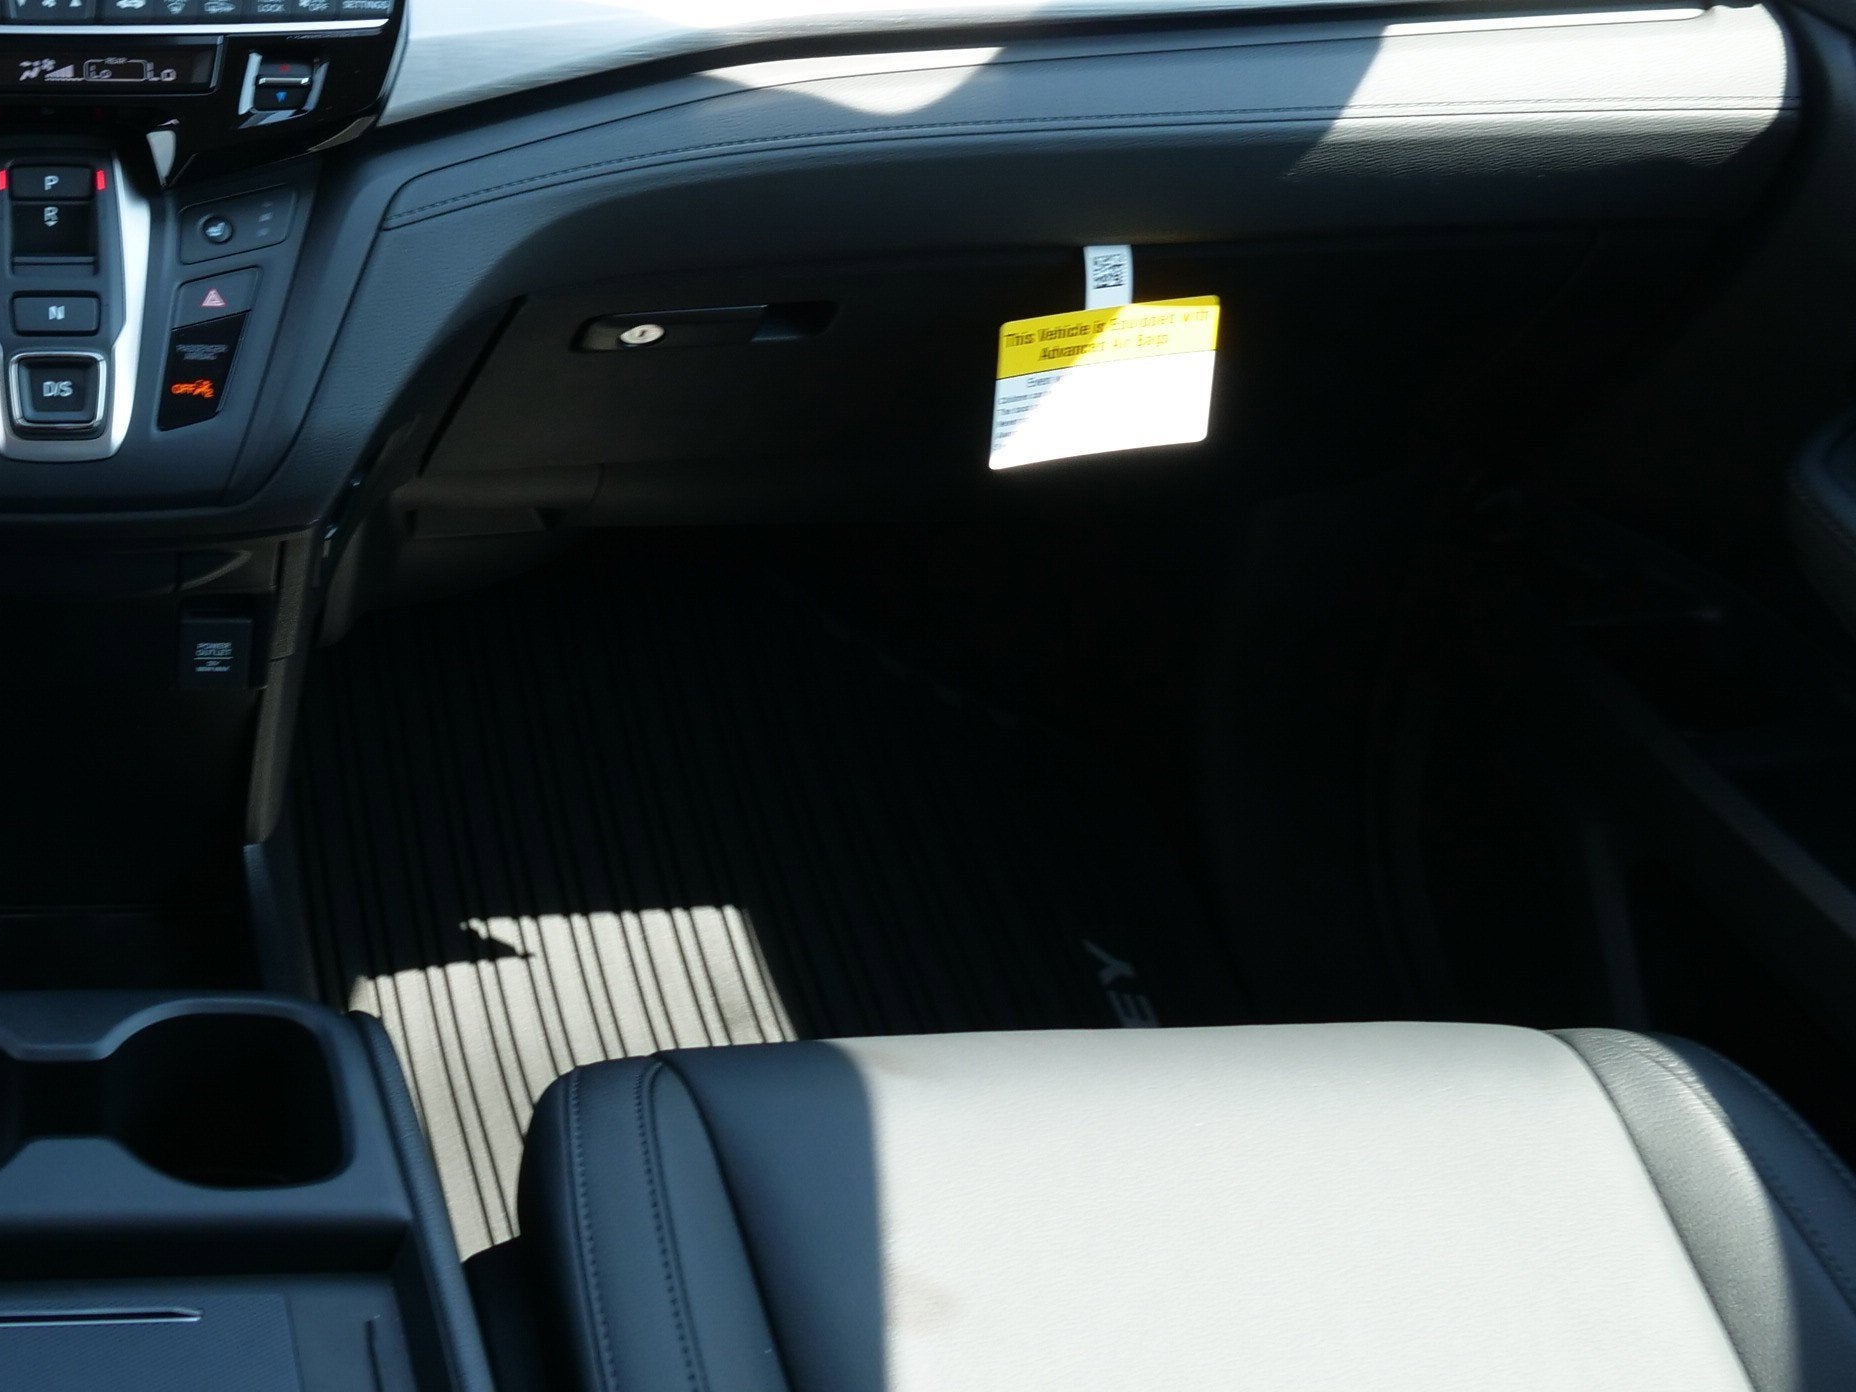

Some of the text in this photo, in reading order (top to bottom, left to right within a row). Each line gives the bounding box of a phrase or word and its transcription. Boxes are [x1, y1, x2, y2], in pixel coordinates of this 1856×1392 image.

[342, 0, 391, 9] SETTINGS
[146, 61, 178, 82] Lo
[44, 175, 60, 191] P
[43, 206, 59, 221] R
[48, 305, 65, 321] N
[1004, 331, 1036, 348] This
[1037, 324, 1091, 342] Vehicle
[42, 380, 74, 397] D/S
